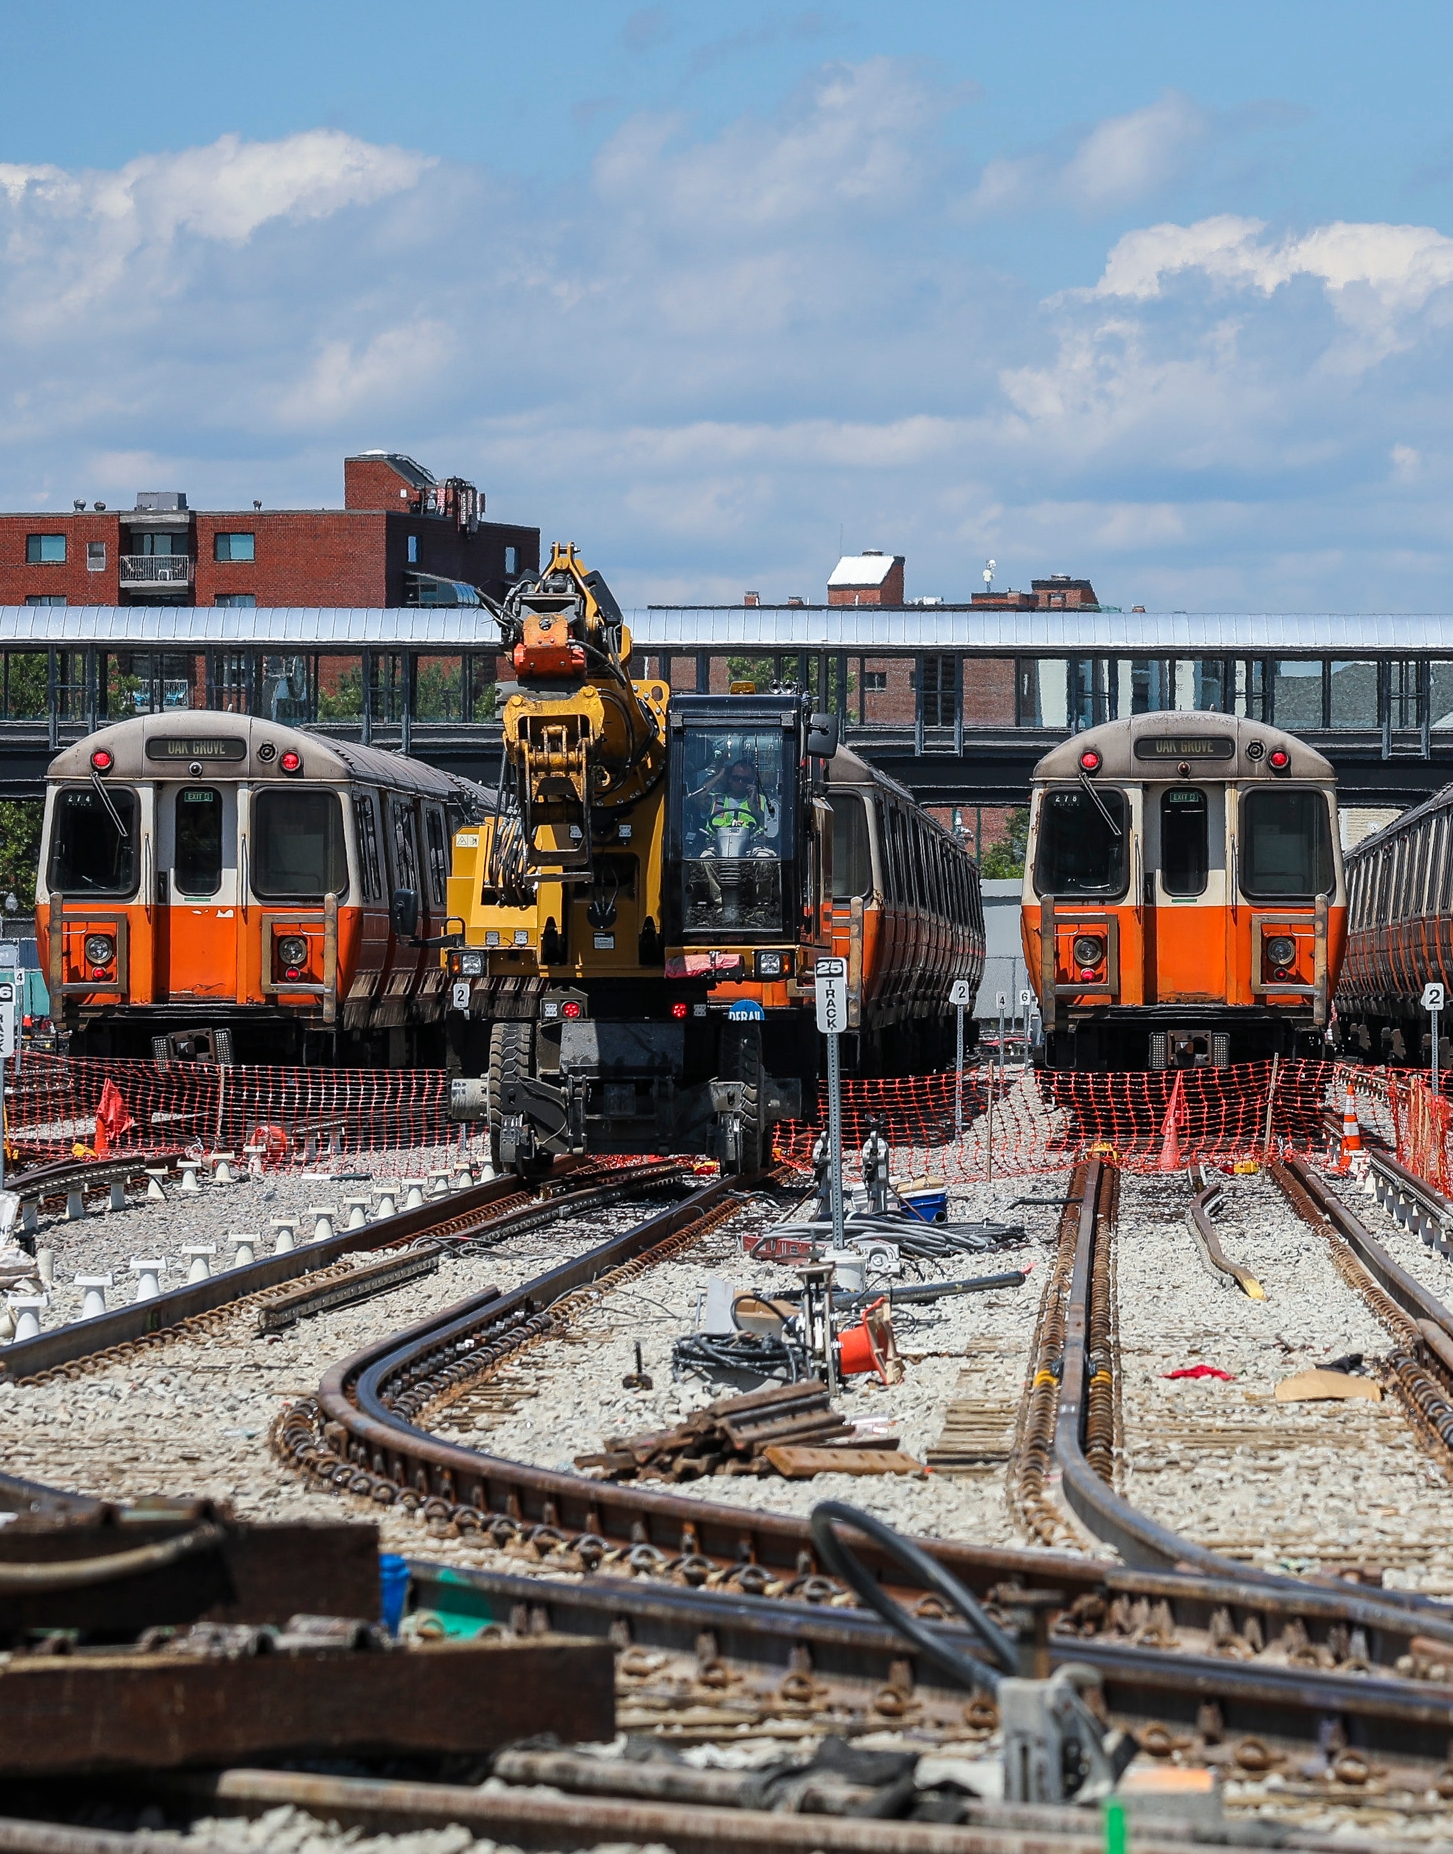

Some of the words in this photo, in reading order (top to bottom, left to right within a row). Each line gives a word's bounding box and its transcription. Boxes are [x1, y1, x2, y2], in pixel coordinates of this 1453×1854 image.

[168, 741, 189, 755] OAK
[192, 741, 226, 755] GROVE
[1155, 740, 1176, 753] OAK
[1180, 740, 1214, 753] GROVE
[1173, 793, 1188, 801] EXIT
[816, 961, 843, 975] 25
[17, 973, 23, 982] 4
[457, 990, 465, 1002] 2
[958, 986, 966, 999] 2
[1021, 992, 1028, 1001] 6
[1428, 989, 1441, 1005] 2
[825, 980, 837, 1029] TRACK
[999, 996, 1005, 1005] 4
